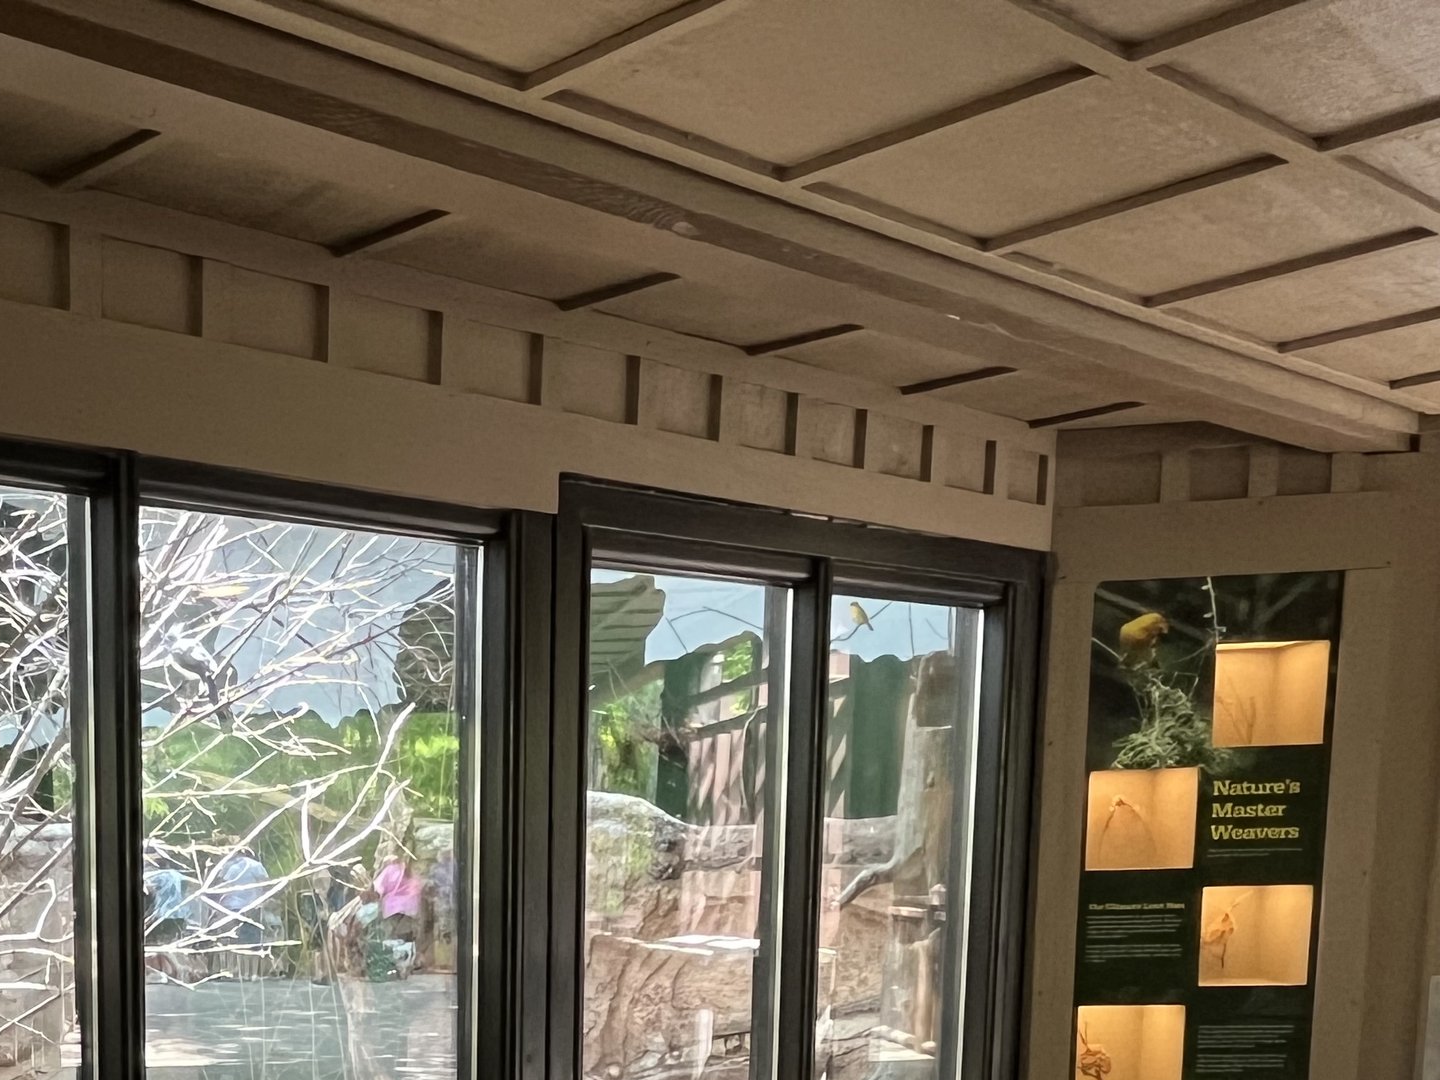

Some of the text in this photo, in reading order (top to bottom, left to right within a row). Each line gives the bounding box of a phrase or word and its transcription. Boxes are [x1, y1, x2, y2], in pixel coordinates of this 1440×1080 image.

[1212, 778, 1301, 796] Nature's
[1211, 802, 1287, 818] Master
[1210, 824, 1300, 840] Weavers
